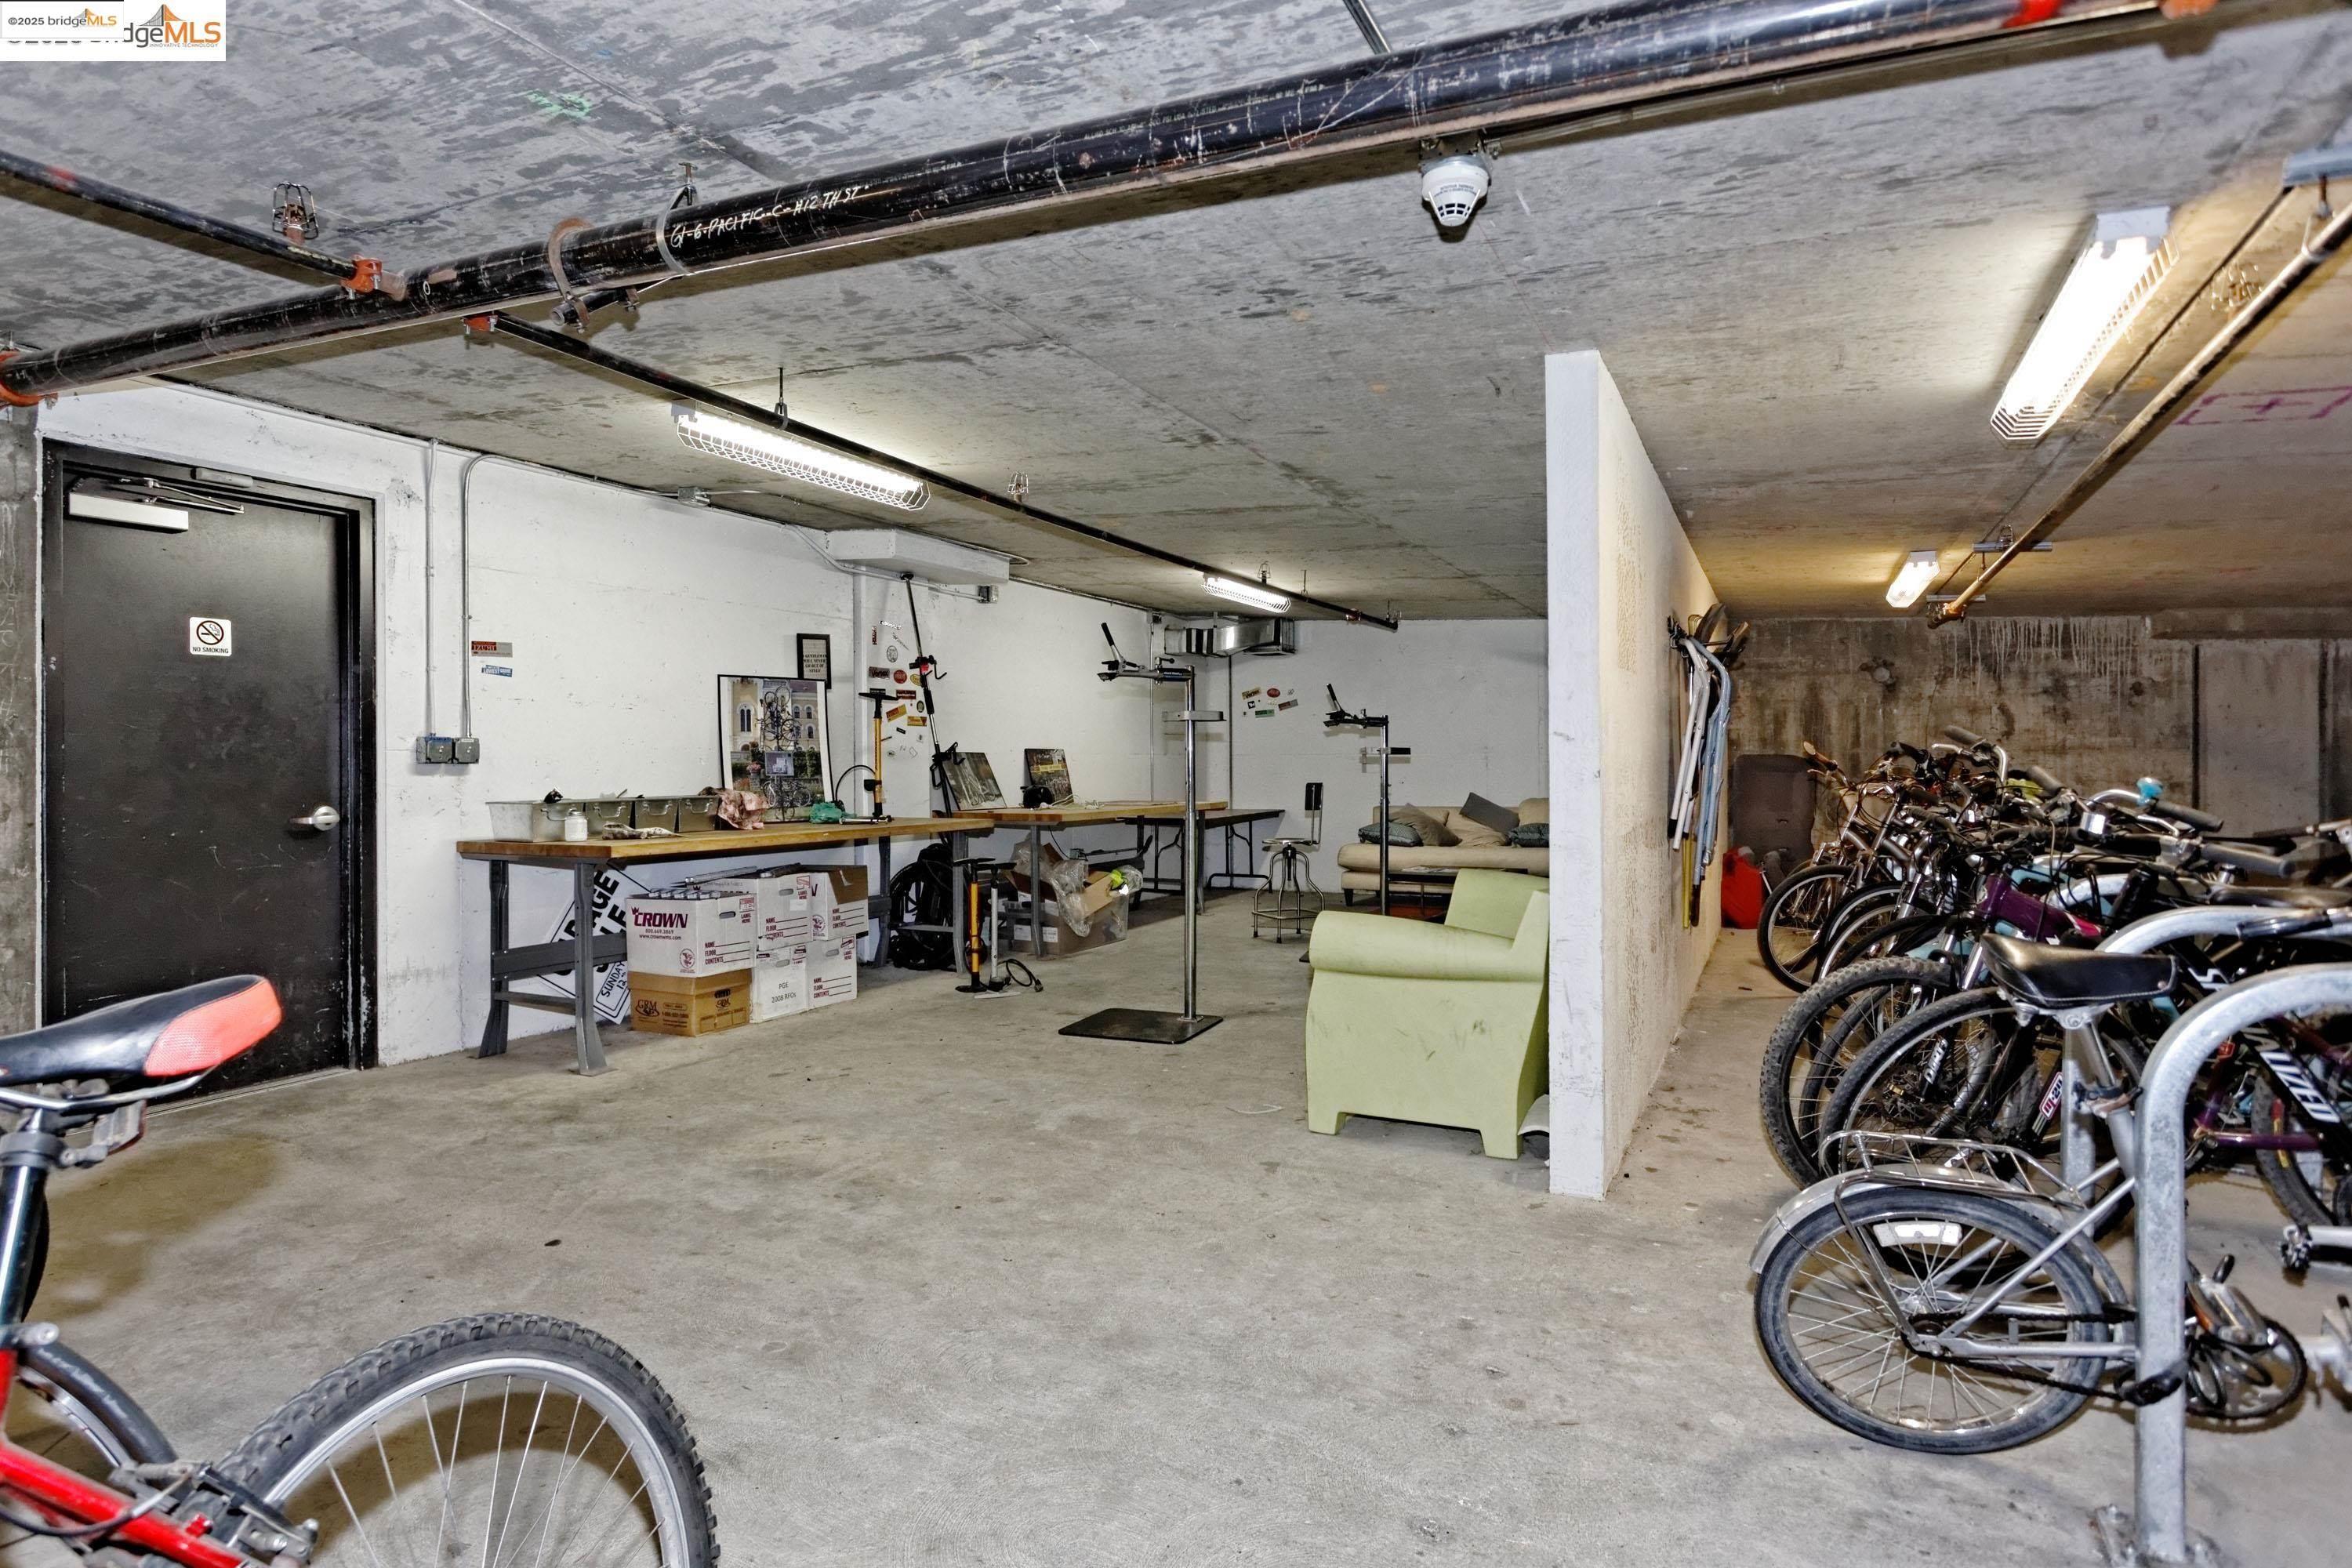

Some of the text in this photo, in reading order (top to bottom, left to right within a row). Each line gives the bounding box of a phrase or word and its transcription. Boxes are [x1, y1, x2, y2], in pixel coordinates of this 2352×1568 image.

[633, 912, 688, 928] CROWN
[705, 956, 724, 965] CONTENTS
[814, 990, 829, 999] CONTENTS
